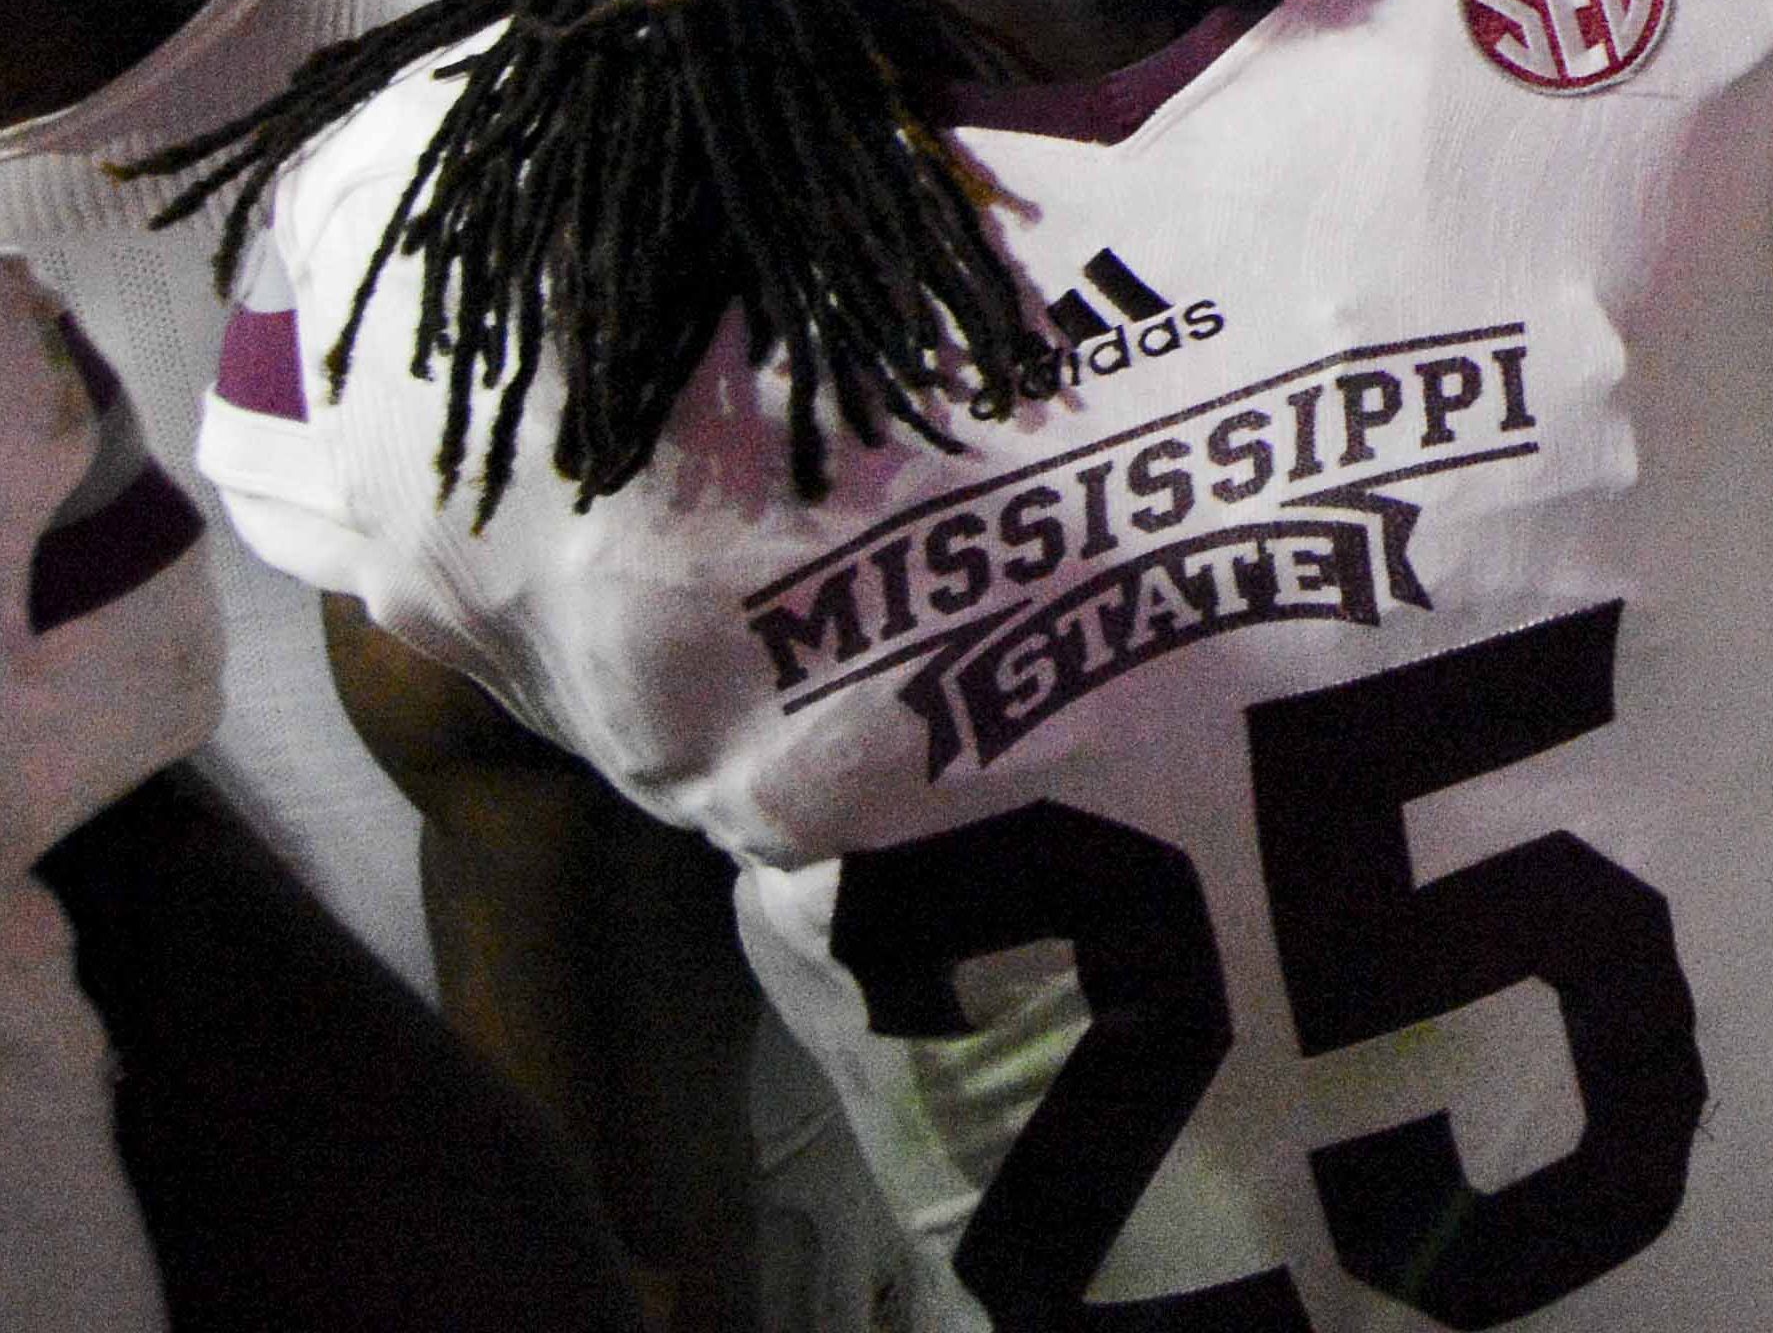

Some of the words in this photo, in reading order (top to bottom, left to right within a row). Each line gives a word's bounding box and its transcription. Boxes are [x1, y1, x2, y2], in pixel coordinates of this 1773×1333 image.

[746, 345, 1539, 691] MISSISSIPPI
[996, 532, 1347, 724] STATE
[829, 597, 1709, 1333] 25
